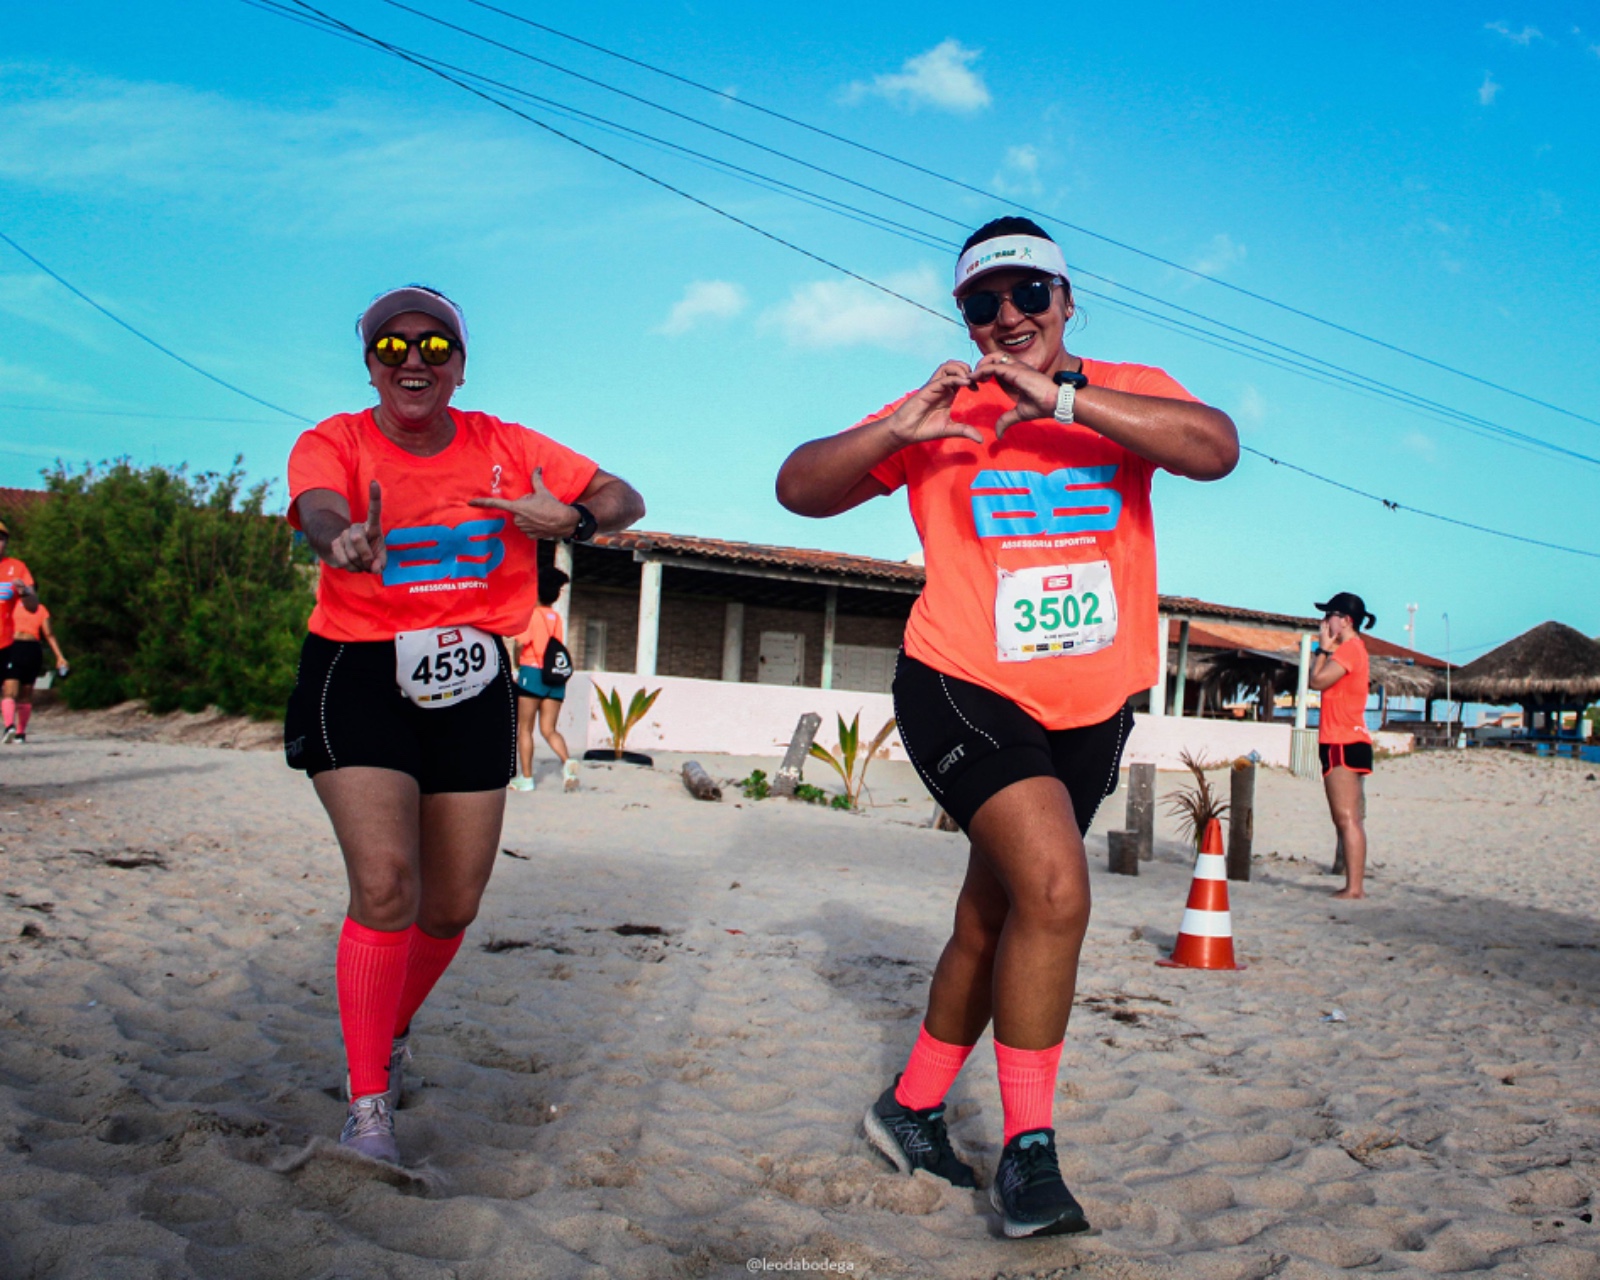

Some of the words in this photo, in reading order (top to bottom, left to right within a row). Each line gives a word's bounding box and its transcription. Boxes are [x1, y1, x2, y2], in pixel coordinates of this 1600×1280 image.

[1001, 540, 1052, 549] ASSESSORIA
[1014, 592, 1102, 632] 3502
[411, 642, 486, 685] 4539
